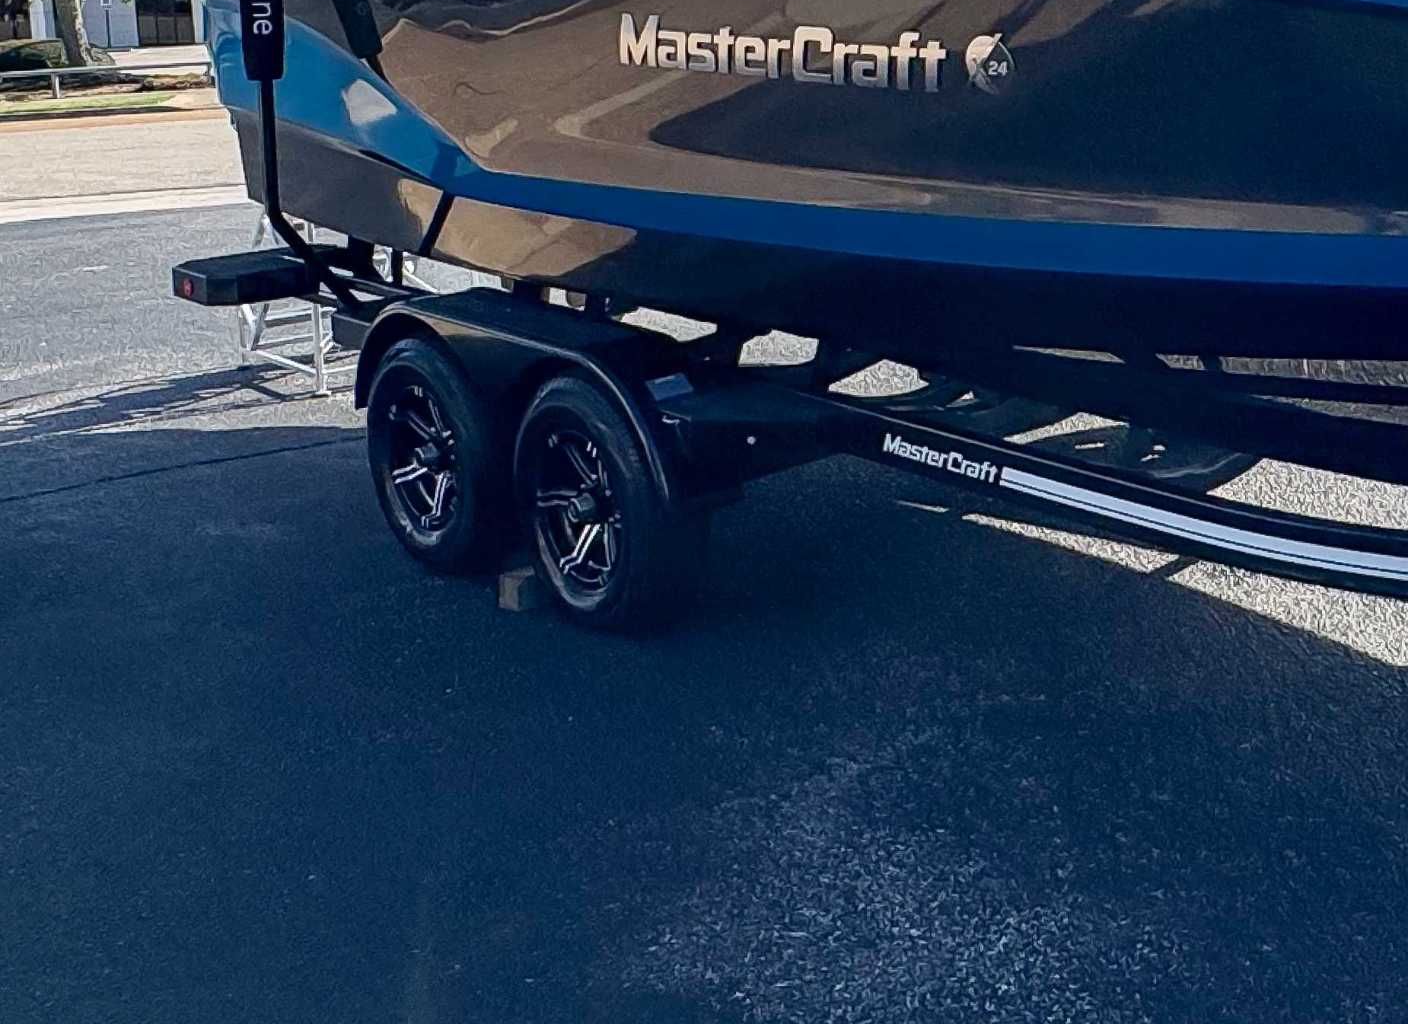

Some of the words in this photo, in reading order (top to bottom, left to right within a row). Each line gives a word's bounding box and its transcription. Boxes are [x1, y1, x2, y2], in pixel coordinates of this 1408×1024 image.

[620, 12, 947, 92] MasterCraft
[988, 60, 1008, 75] 24
[883, 433, 999, 483] MasterCraft
